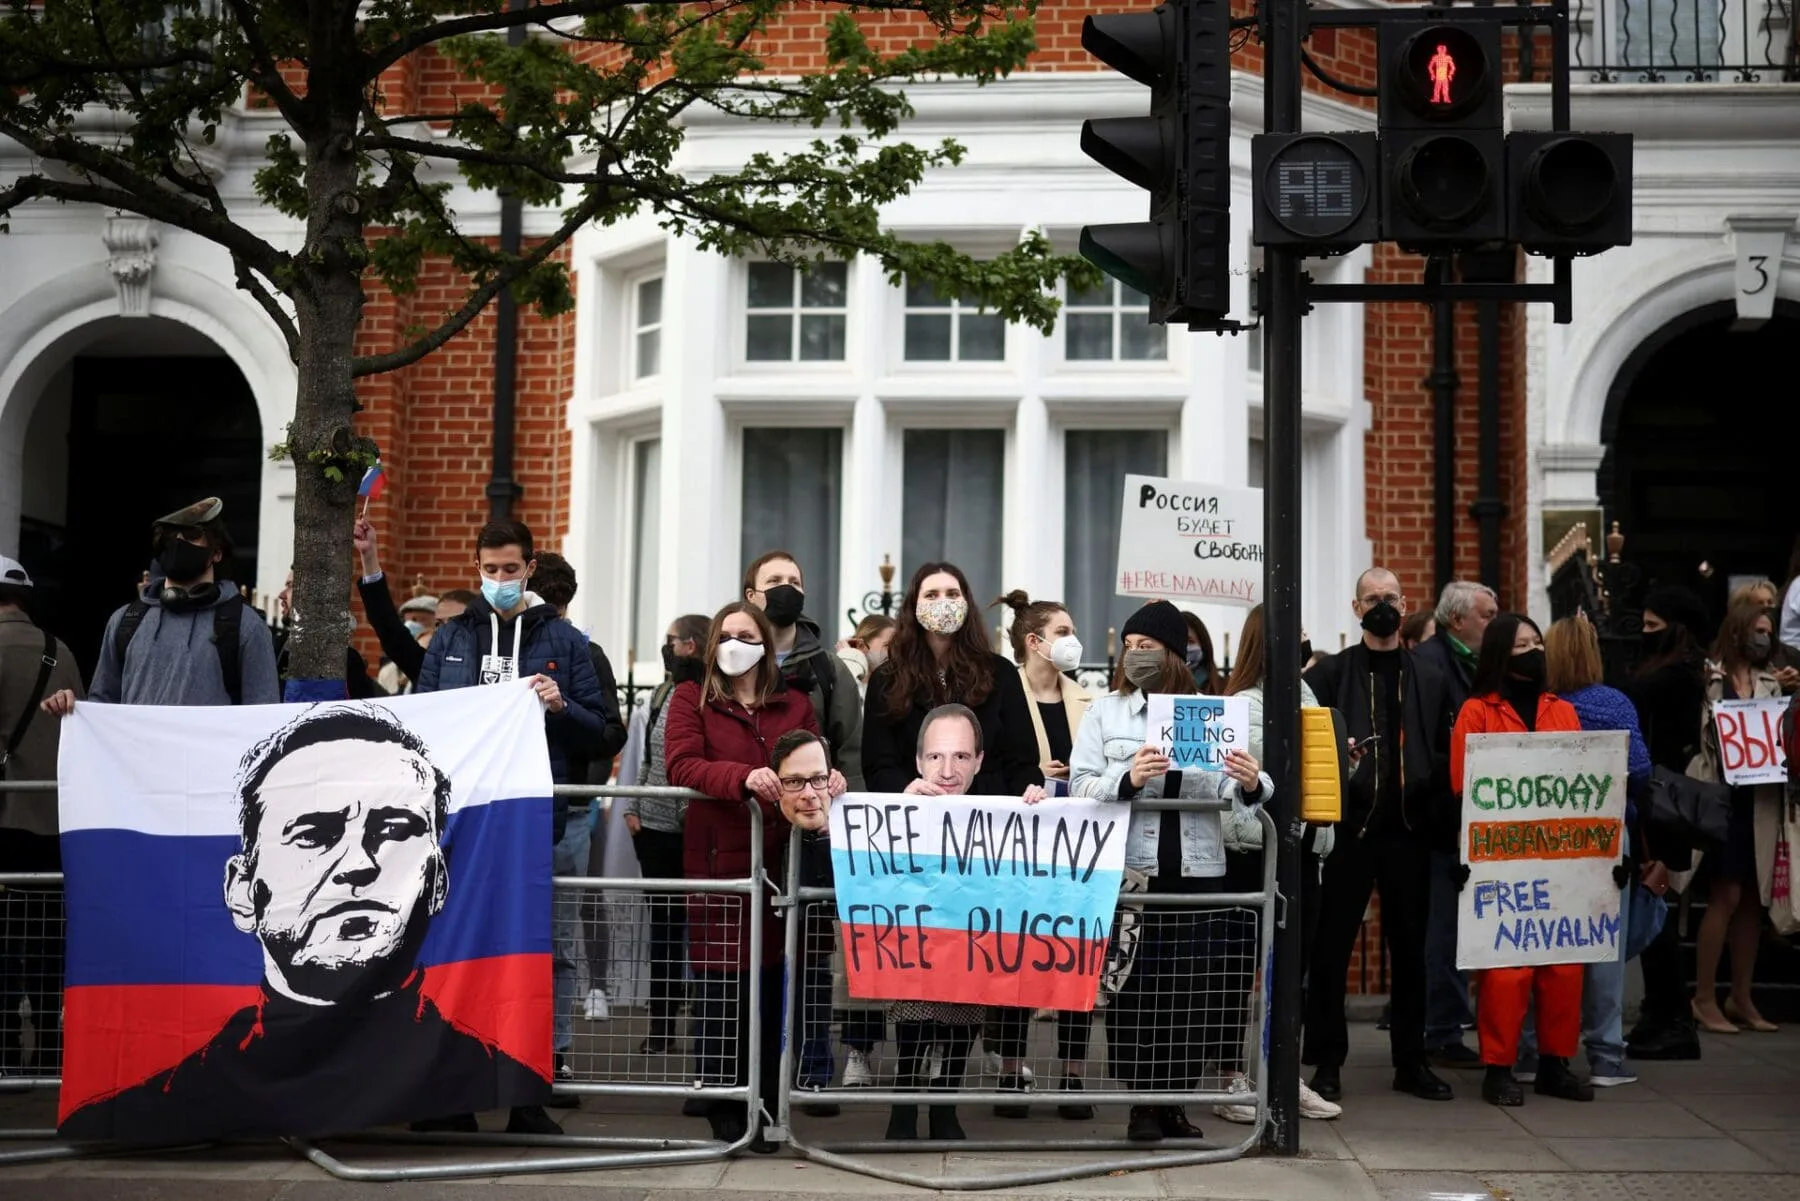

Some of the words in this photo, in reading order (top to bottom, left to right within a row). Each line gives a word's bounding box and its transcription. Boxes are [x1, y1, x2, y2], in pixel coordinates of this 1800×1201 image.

[1742, 256, 1769, 295] 3
[1177, 516, 1235, 535] БУДЕТ
[1173, 706, 1225, 722] STOP
[1161, 726, 1235, 743] KILLING
[1160, 747, 1242, 763] AVALN
[1471, 773, 1613, 812] СВОБОДУ
[842, 804, 924, 877] FREE
[940, 808, 1116, 883] NAVALNY
[1472, 823, 1619, 857] НАВАЛЬНОМУ
[1473, 879, 1551, 919] FREE
[848, 904, 932, 973] FREE
[967, 906, 1106, 976] RUSSIA
[1494, 913, 1621, 952] NAVALNY
